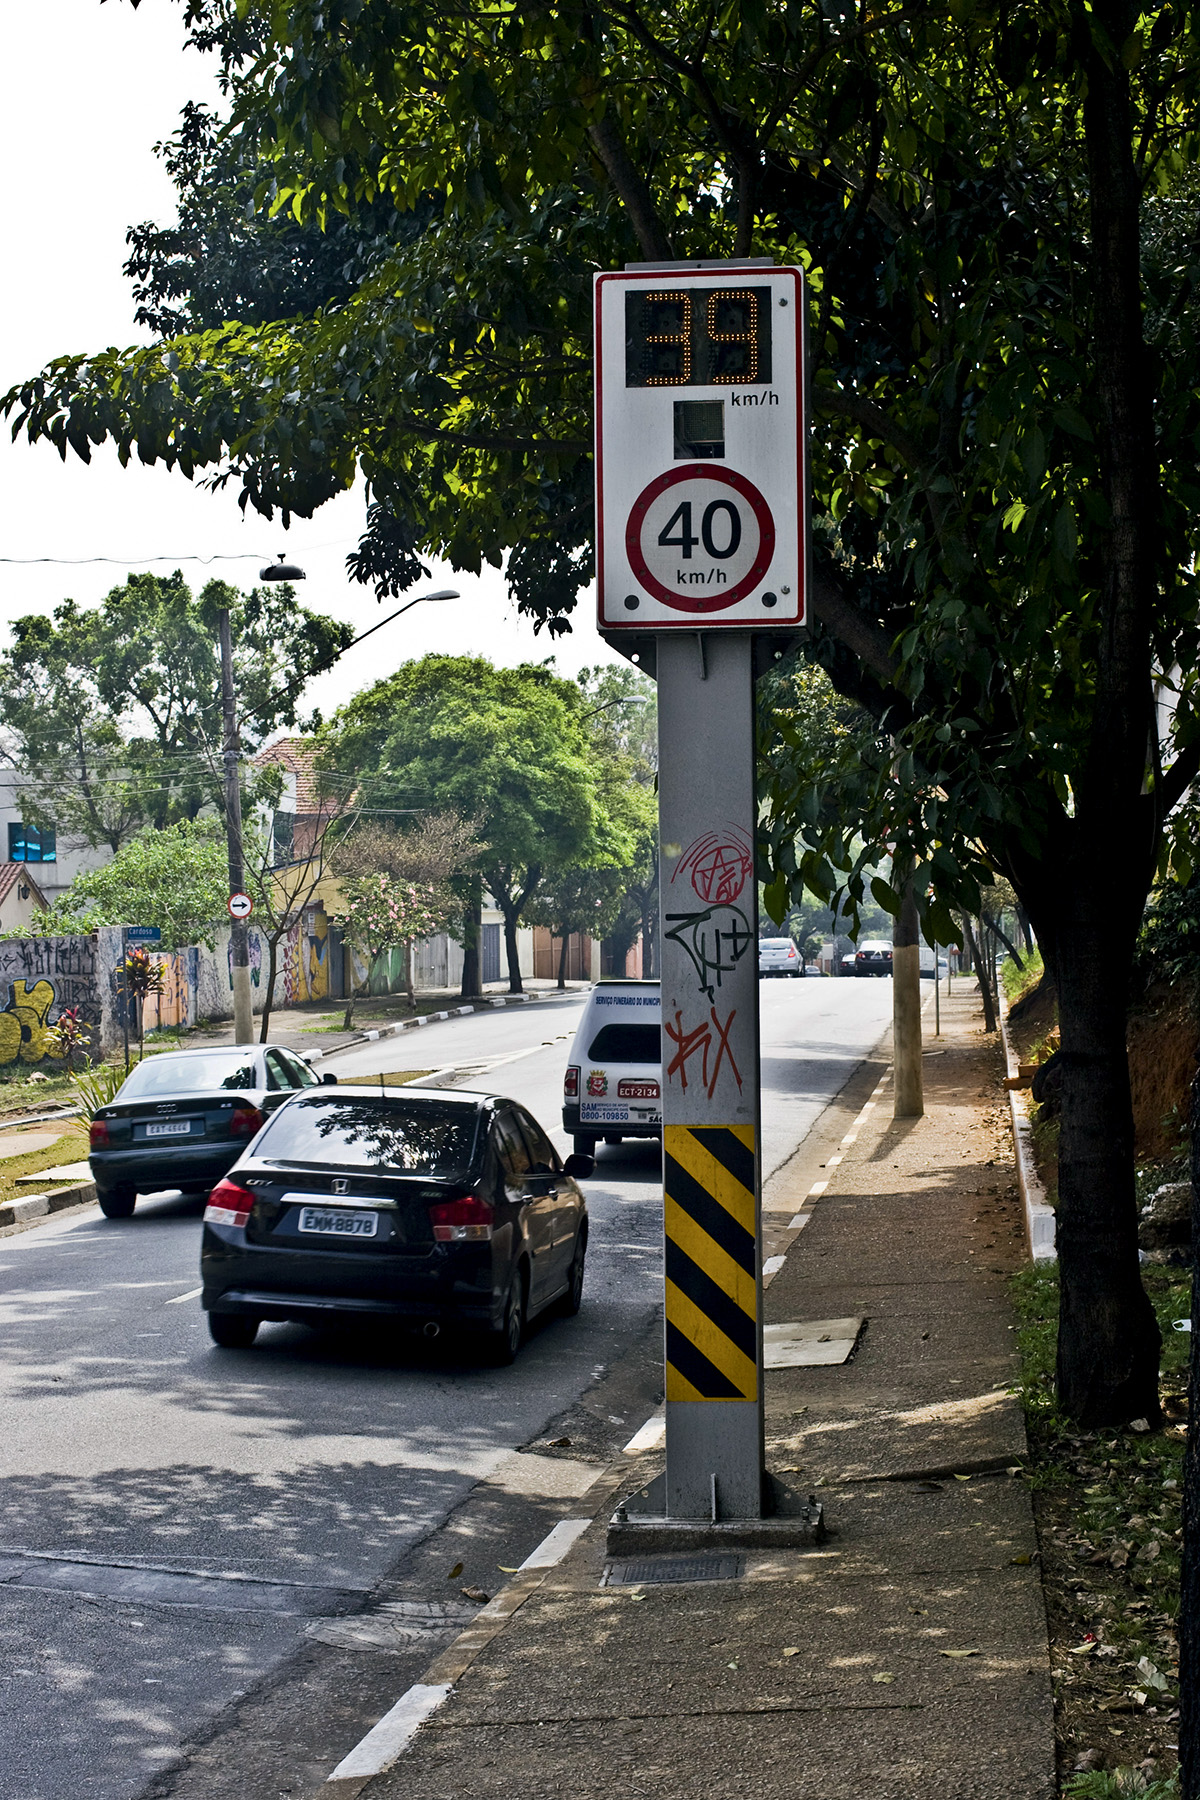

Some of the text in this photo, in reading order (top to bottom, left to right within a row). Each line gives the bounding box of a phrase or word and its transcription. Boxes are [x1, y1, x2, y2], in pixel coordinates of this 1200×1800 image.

[646, 291, 757, 385] 39
[731, 390, 779, 407] km/h
[657, 499, 742, 560] 40
[676, 568, 728, 584] km/h
[581, 1103, 597, 1111] SAM
[581, 1112, 629, 1120] 0800-109850
